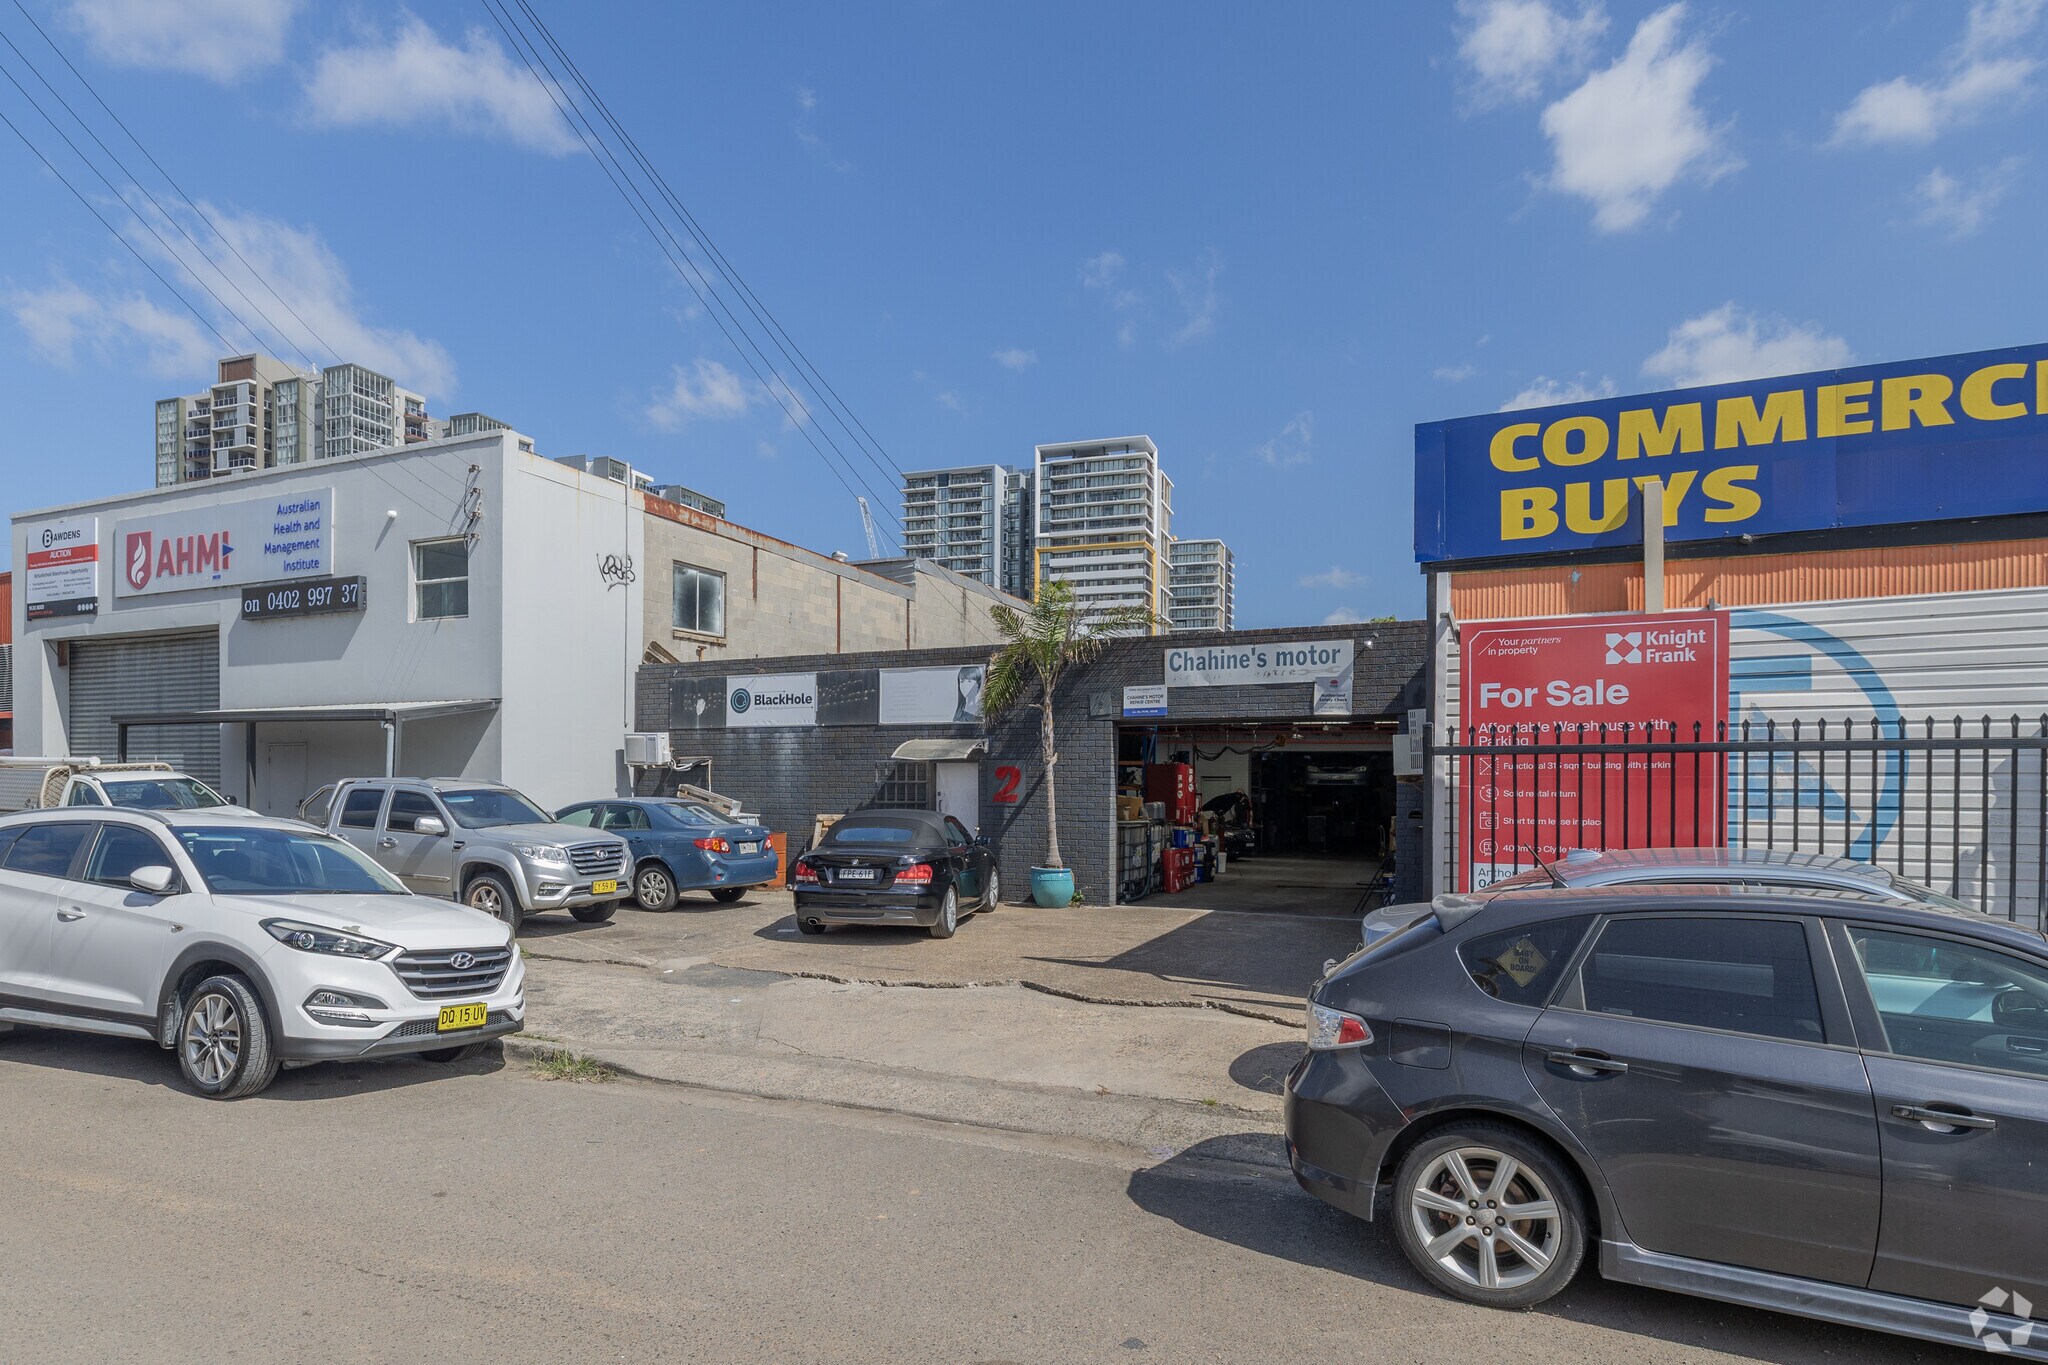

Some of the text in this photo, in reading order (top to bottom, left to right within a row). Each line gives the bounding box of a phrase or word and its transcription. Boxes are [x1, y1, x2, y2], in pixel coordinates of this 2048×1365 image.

[277, 500, 321, 516] Australian
[1500, 465, 1762, 541] BUYS
[273, 517, 320, 535] Health and
[50, 549, 72, 559] AUCTION
[156, 530, 229, 578] AHMI
[264, 538, 320, 555] Management
[283, 558, 320, 572] Institute
[244, 583, 358, 612] on 0402 997 37
[1498, 636, 1562, 647] Your partners
[1646, 629, 1706, 648] Knight
[1169, 645, 1341, 672] Chahine's motor
[1498, 646, 1538, 656] property
[1646, 647, 1696, 663] Frank
[754, 693, 813, 706] BlackHole
[1480, 679, 1630, 709] For Sale
[1503, 762, 1546, 770] Fuctioal
[1547, 762, 1562, 770] 31
[1587, 761, 1621, 771] buiding
[1624, 761, 1641, 770] ith
[1643, 761, 1675, 771] parkin
[991, 765, 1022, 803] 2
[1503, 790, 1524, 798] Soid
[1525, 790, 1549, 798] retal
[1526, 818, 1546, 826] tem
[1548, 818, 1570, 826] lese
[1582, 818, 1604, 827] plac
[1518, 957, 1529, 965] ON
